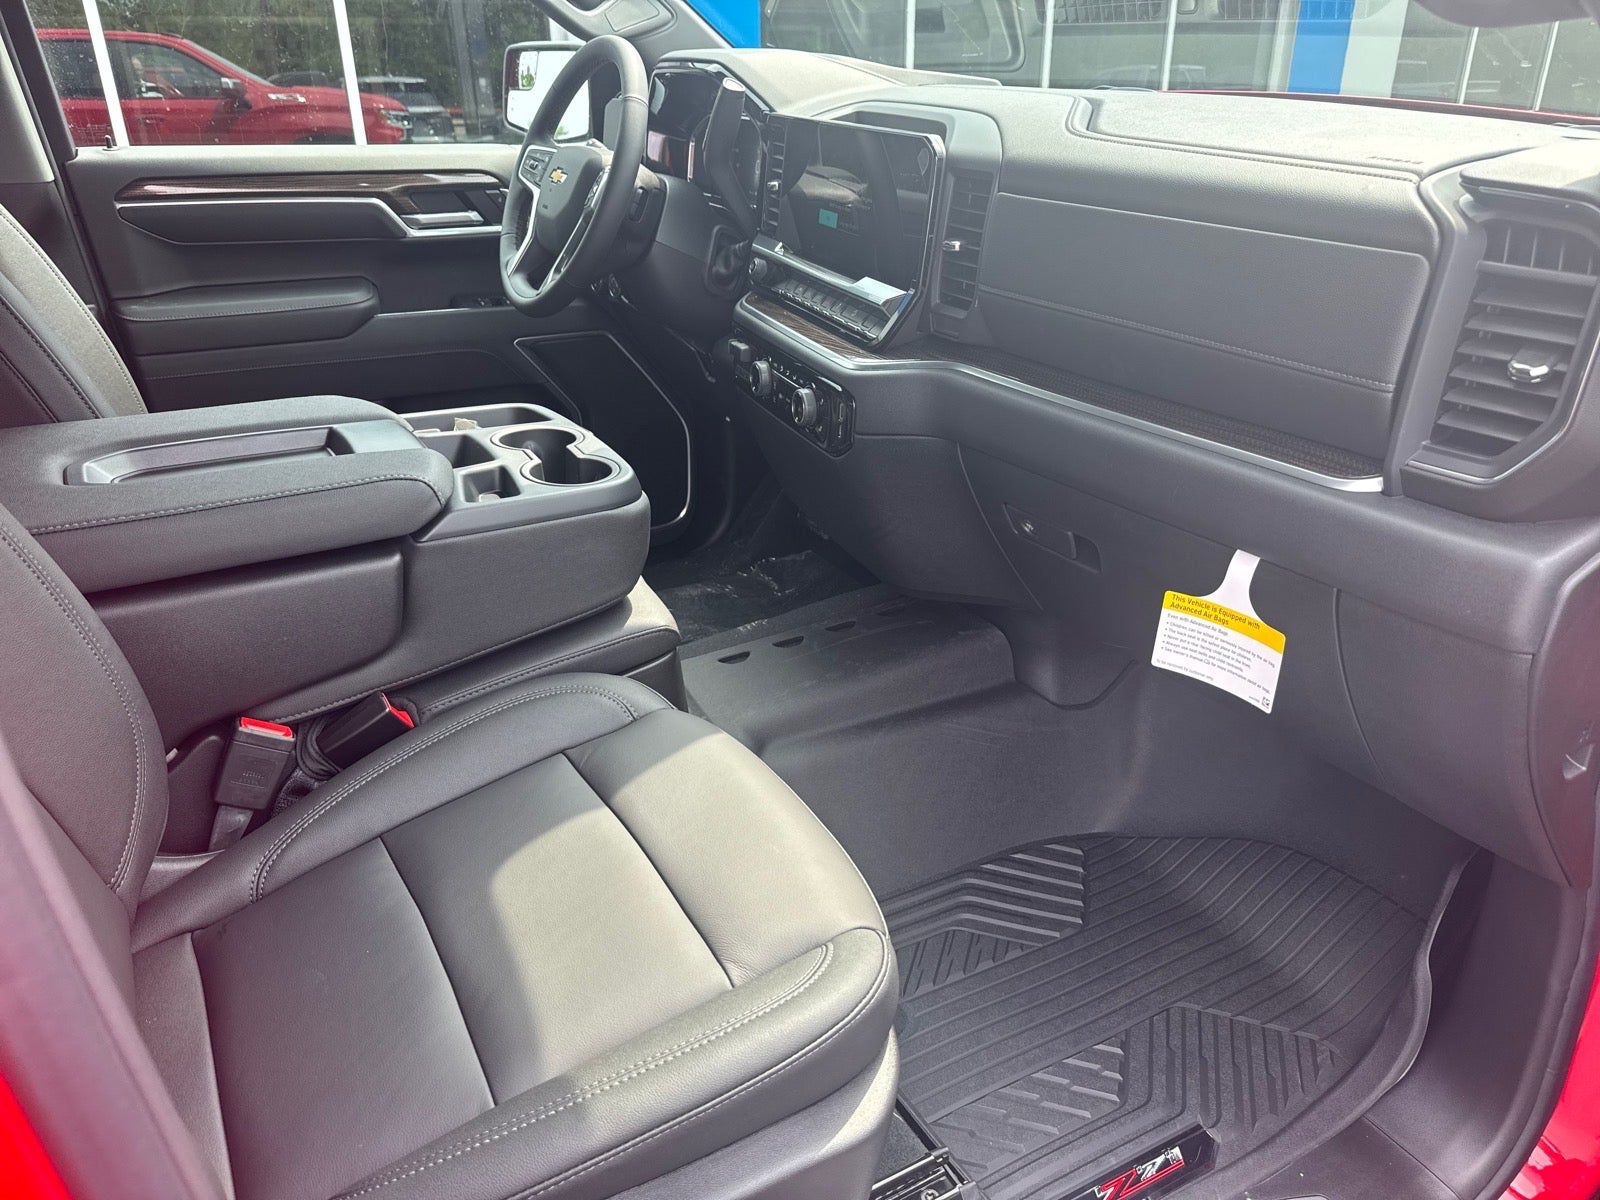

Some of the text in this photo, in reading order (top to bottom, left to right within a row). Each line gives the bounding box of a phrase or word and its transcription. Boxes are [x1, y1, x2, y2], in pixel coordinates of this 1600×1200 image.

[1170, 602, 1229, 626] Advanced Air Bags
[1172, 594, 1186, 603] This
[1188, 598, 1210, 610] Vehicle
[1218, 608, 1246, 624] Equipped
[1248, 620, 1260, 630] with
